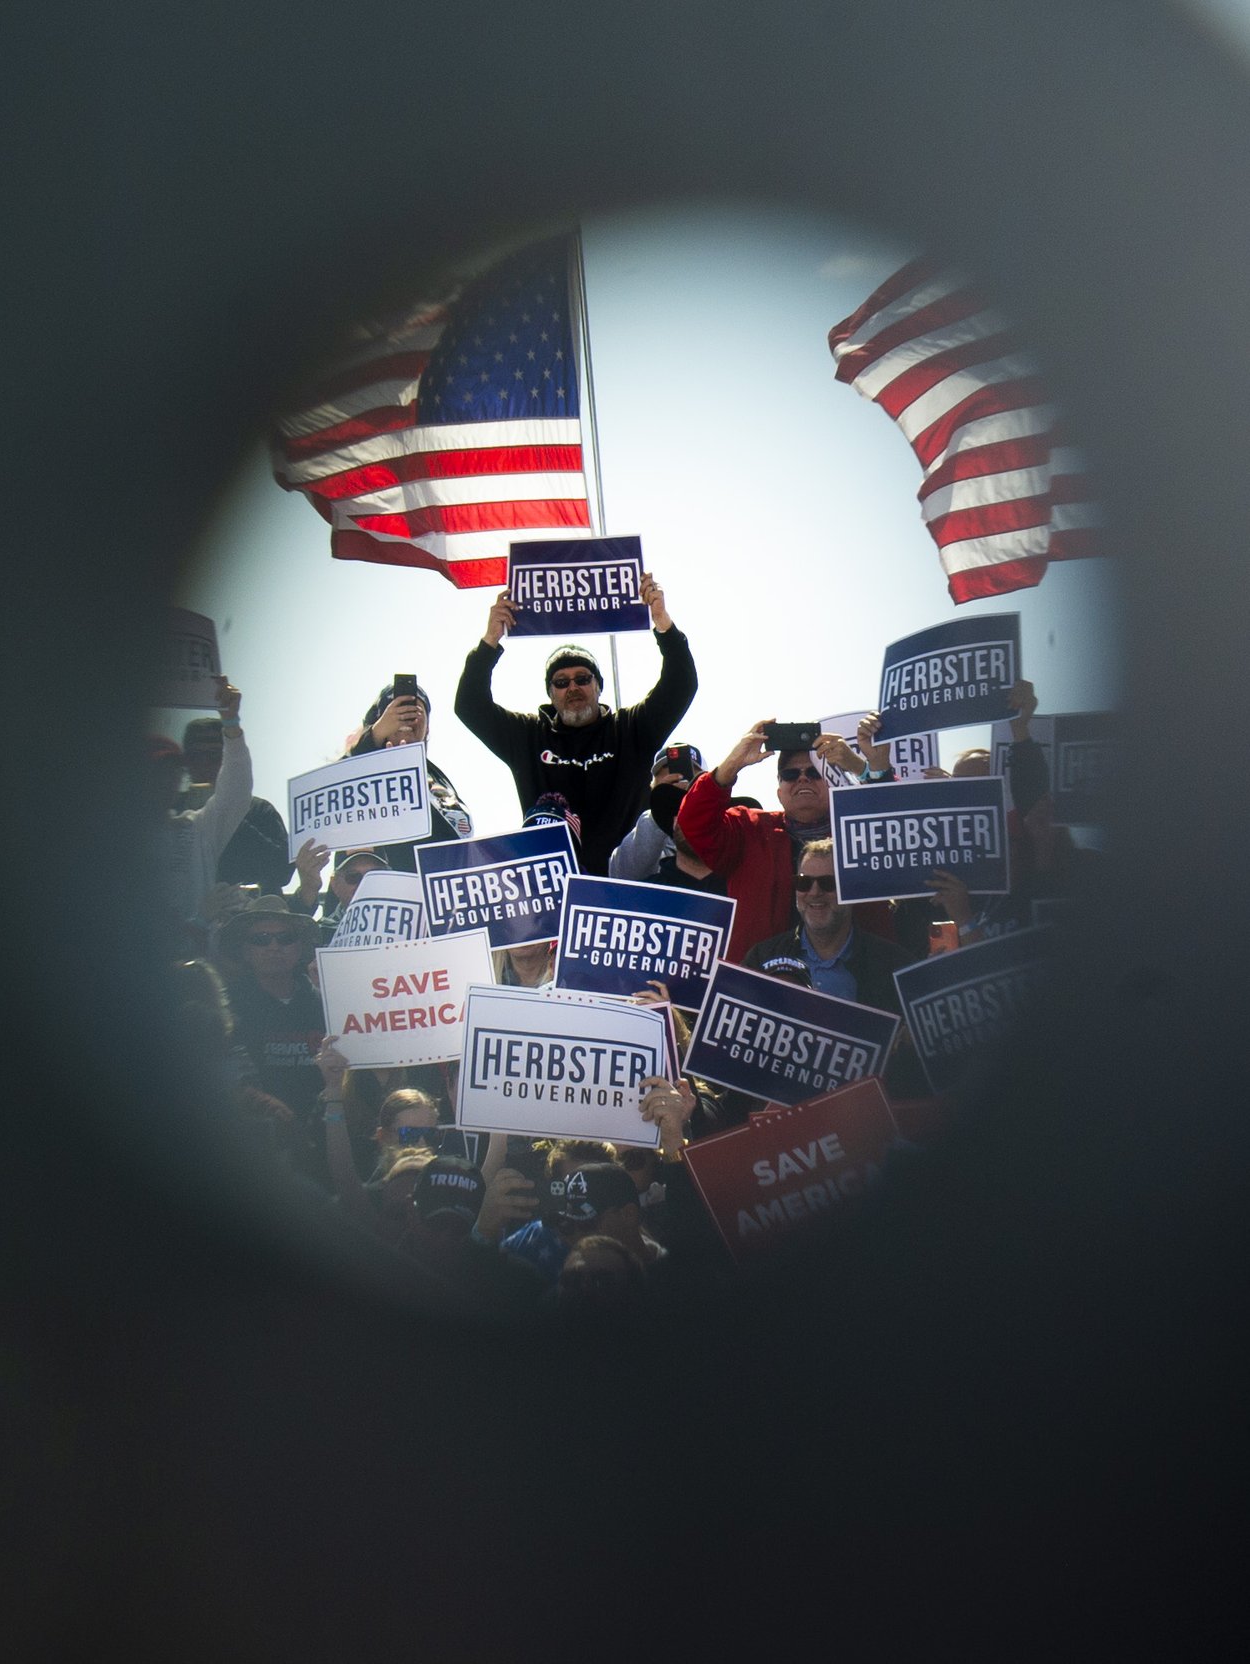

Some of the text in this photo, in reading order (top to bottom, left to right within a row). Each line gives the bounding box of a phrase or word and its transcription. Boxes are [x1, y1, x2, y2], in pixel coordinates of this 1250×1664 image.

[517, 566, 635, 603] HERBSTER
[533, 597, 620, 613] GOVERNOR
[886, 648, 1006, 703] HERBSTER
[900, 682, 989, 711] GOVERNOR
[300, 774, 415, 826] HERBSTER
[313, 804, 400, 829] GOVERNOR
[535, 816, 559, 825] TRU
[849, 814, 991, 860] HERBSTER
[870, 849, 973, 871] GOVERNOR
[433, 860, 567, 917] HERBSTER
[336, 904, 414, 941] RBSTER
[455, 896, 556, 926] GOVERNOR
[574, 912, 714, 971] HERBSTER
[590, 950, 690, 980] GOVERNOR
[762, 956, 806, 970] TRUMP
[371, 969, 451, 999] SAVE
[342, 1001, 465, 1035] AMERIC
[713, 1003, 868, 1081] HERBSTER
[482, 1037, 647, 1095] HERBSTER
[729, 1044, 839, 1091] GOVERNOR
[502, 1080, 624, 1107] GOVERNOR
[752, 1132, 846, 1186] SAVE
[430, 1173, 478, 1192] TRUMP
